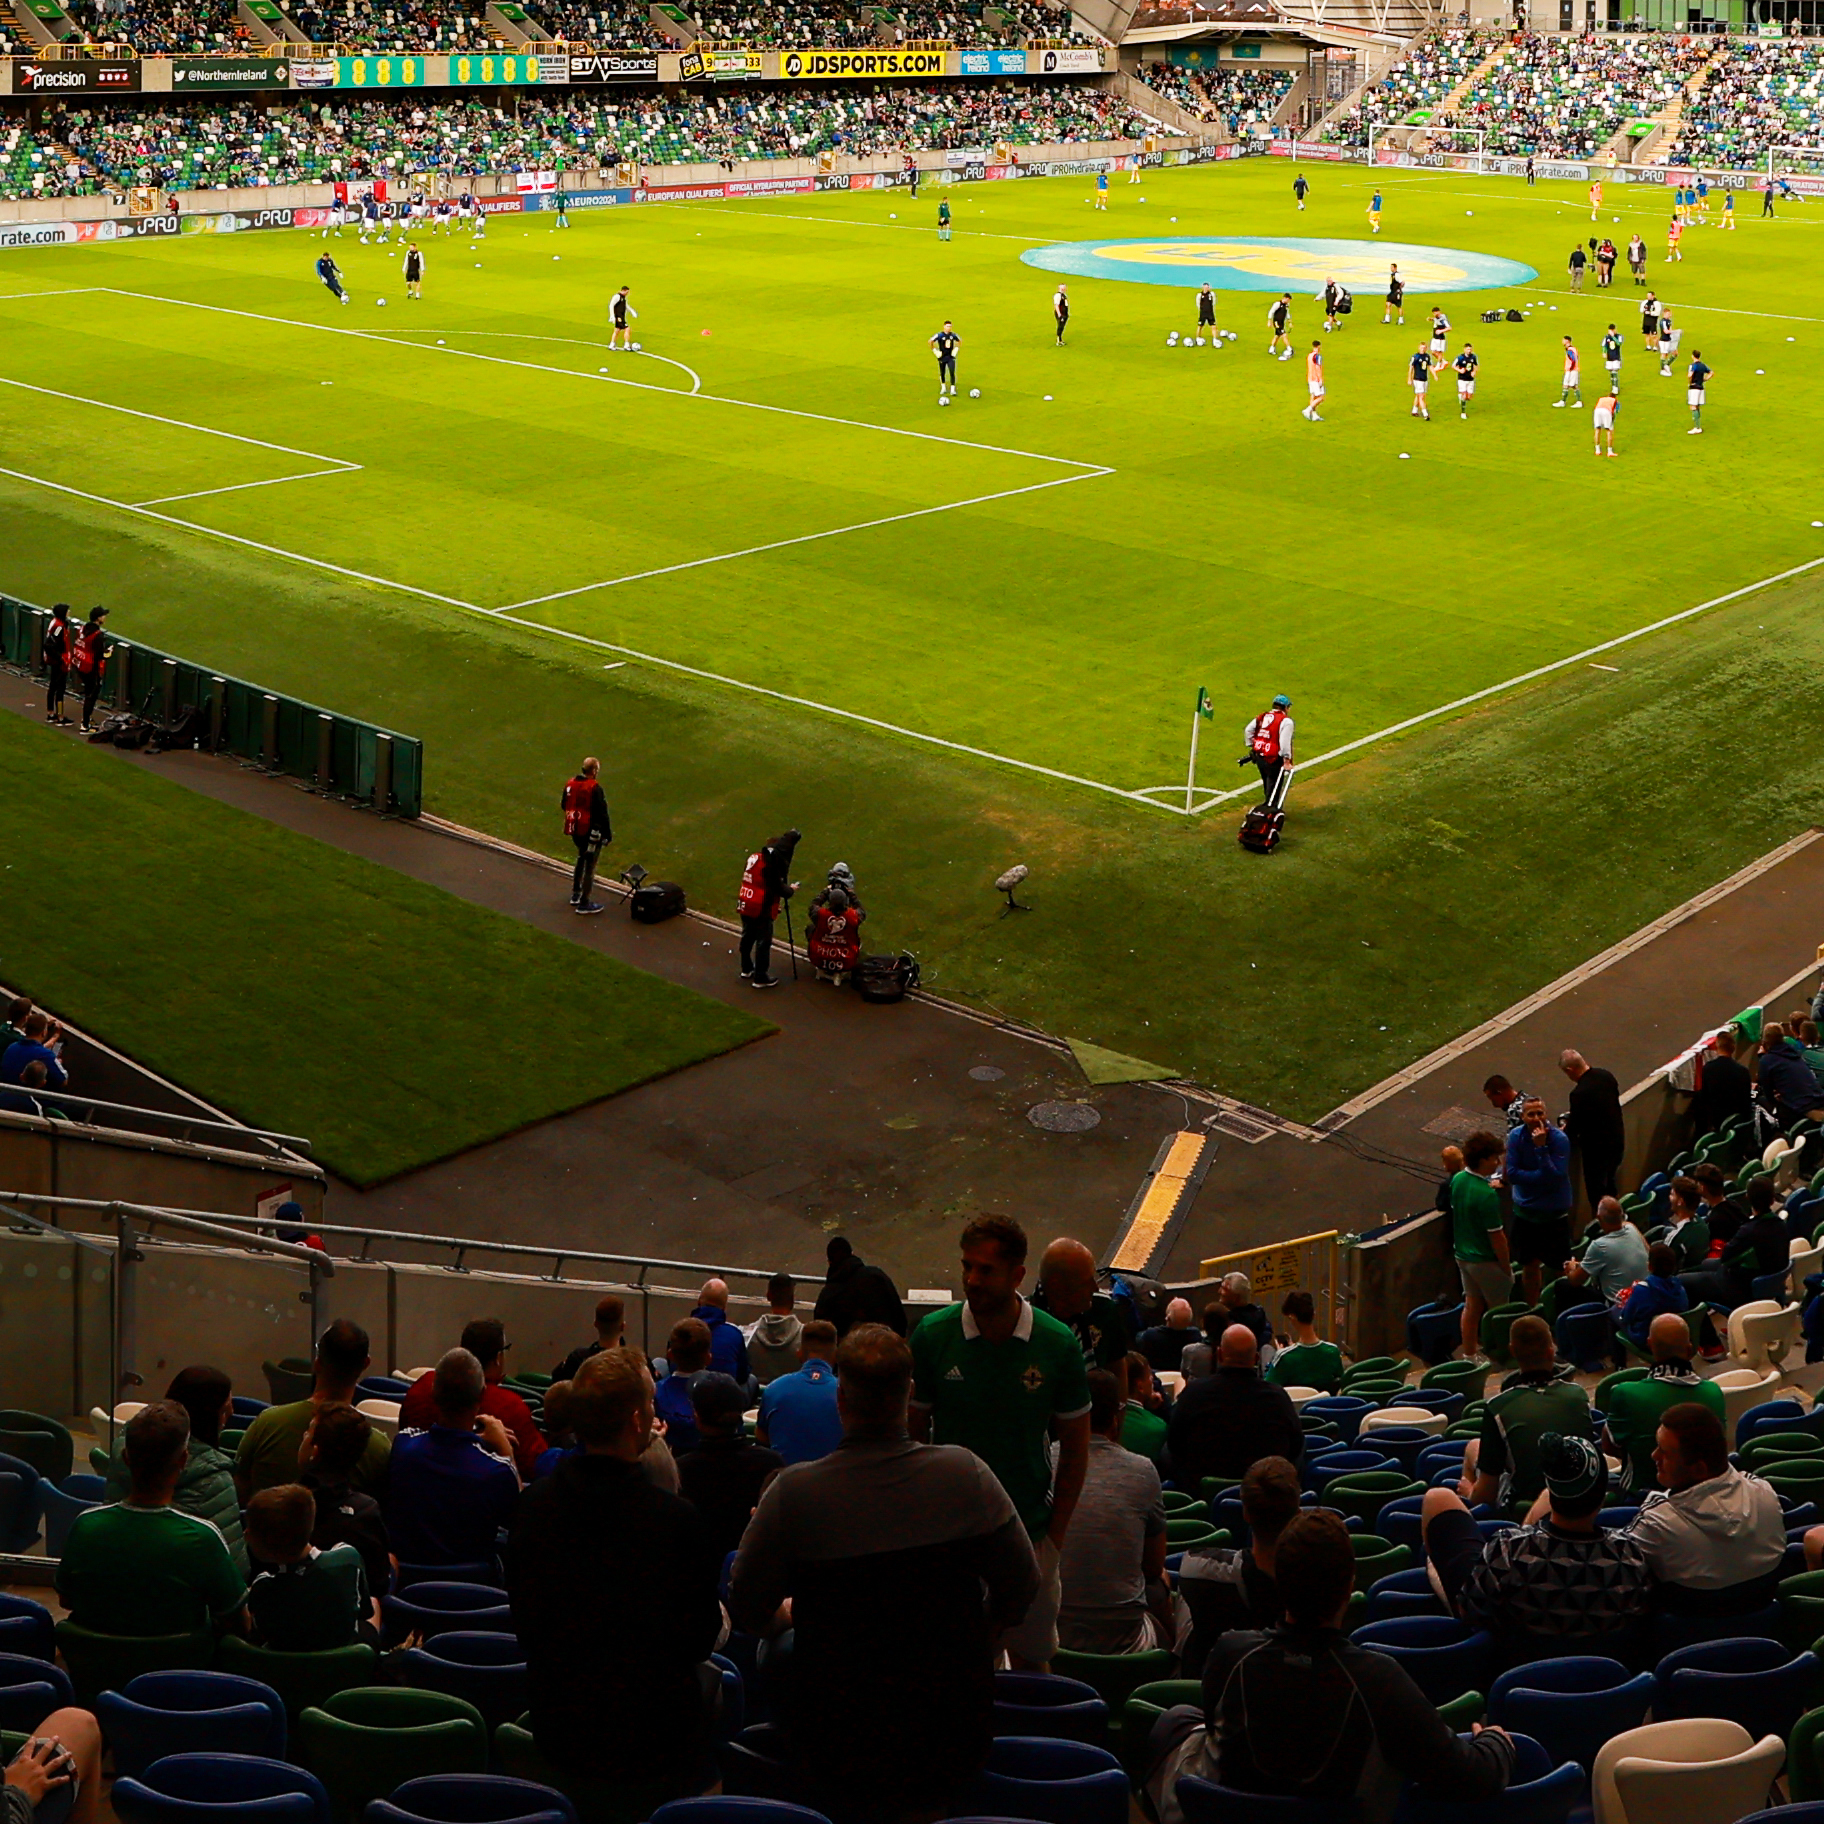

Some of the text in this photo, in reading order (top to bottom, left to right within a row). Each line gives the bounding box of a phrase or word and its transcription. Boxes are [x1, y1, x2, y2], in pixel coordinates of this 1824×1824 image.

[806, 56, 940, 74] JDSPORTS.COM
[33, 71, 86, 89] precision
[188, 69, 267, 81] @NorthernIreland
[1051, 162, 1111, 176] iPROHydrate.com
[1508, 163, 1581, 179] iPROydrate.com
[116, 195, 123, 205] 7
[648, 188, 724, 202] EUROPEAN QUALIFIERS
[822, 960, 844, 971] 109
